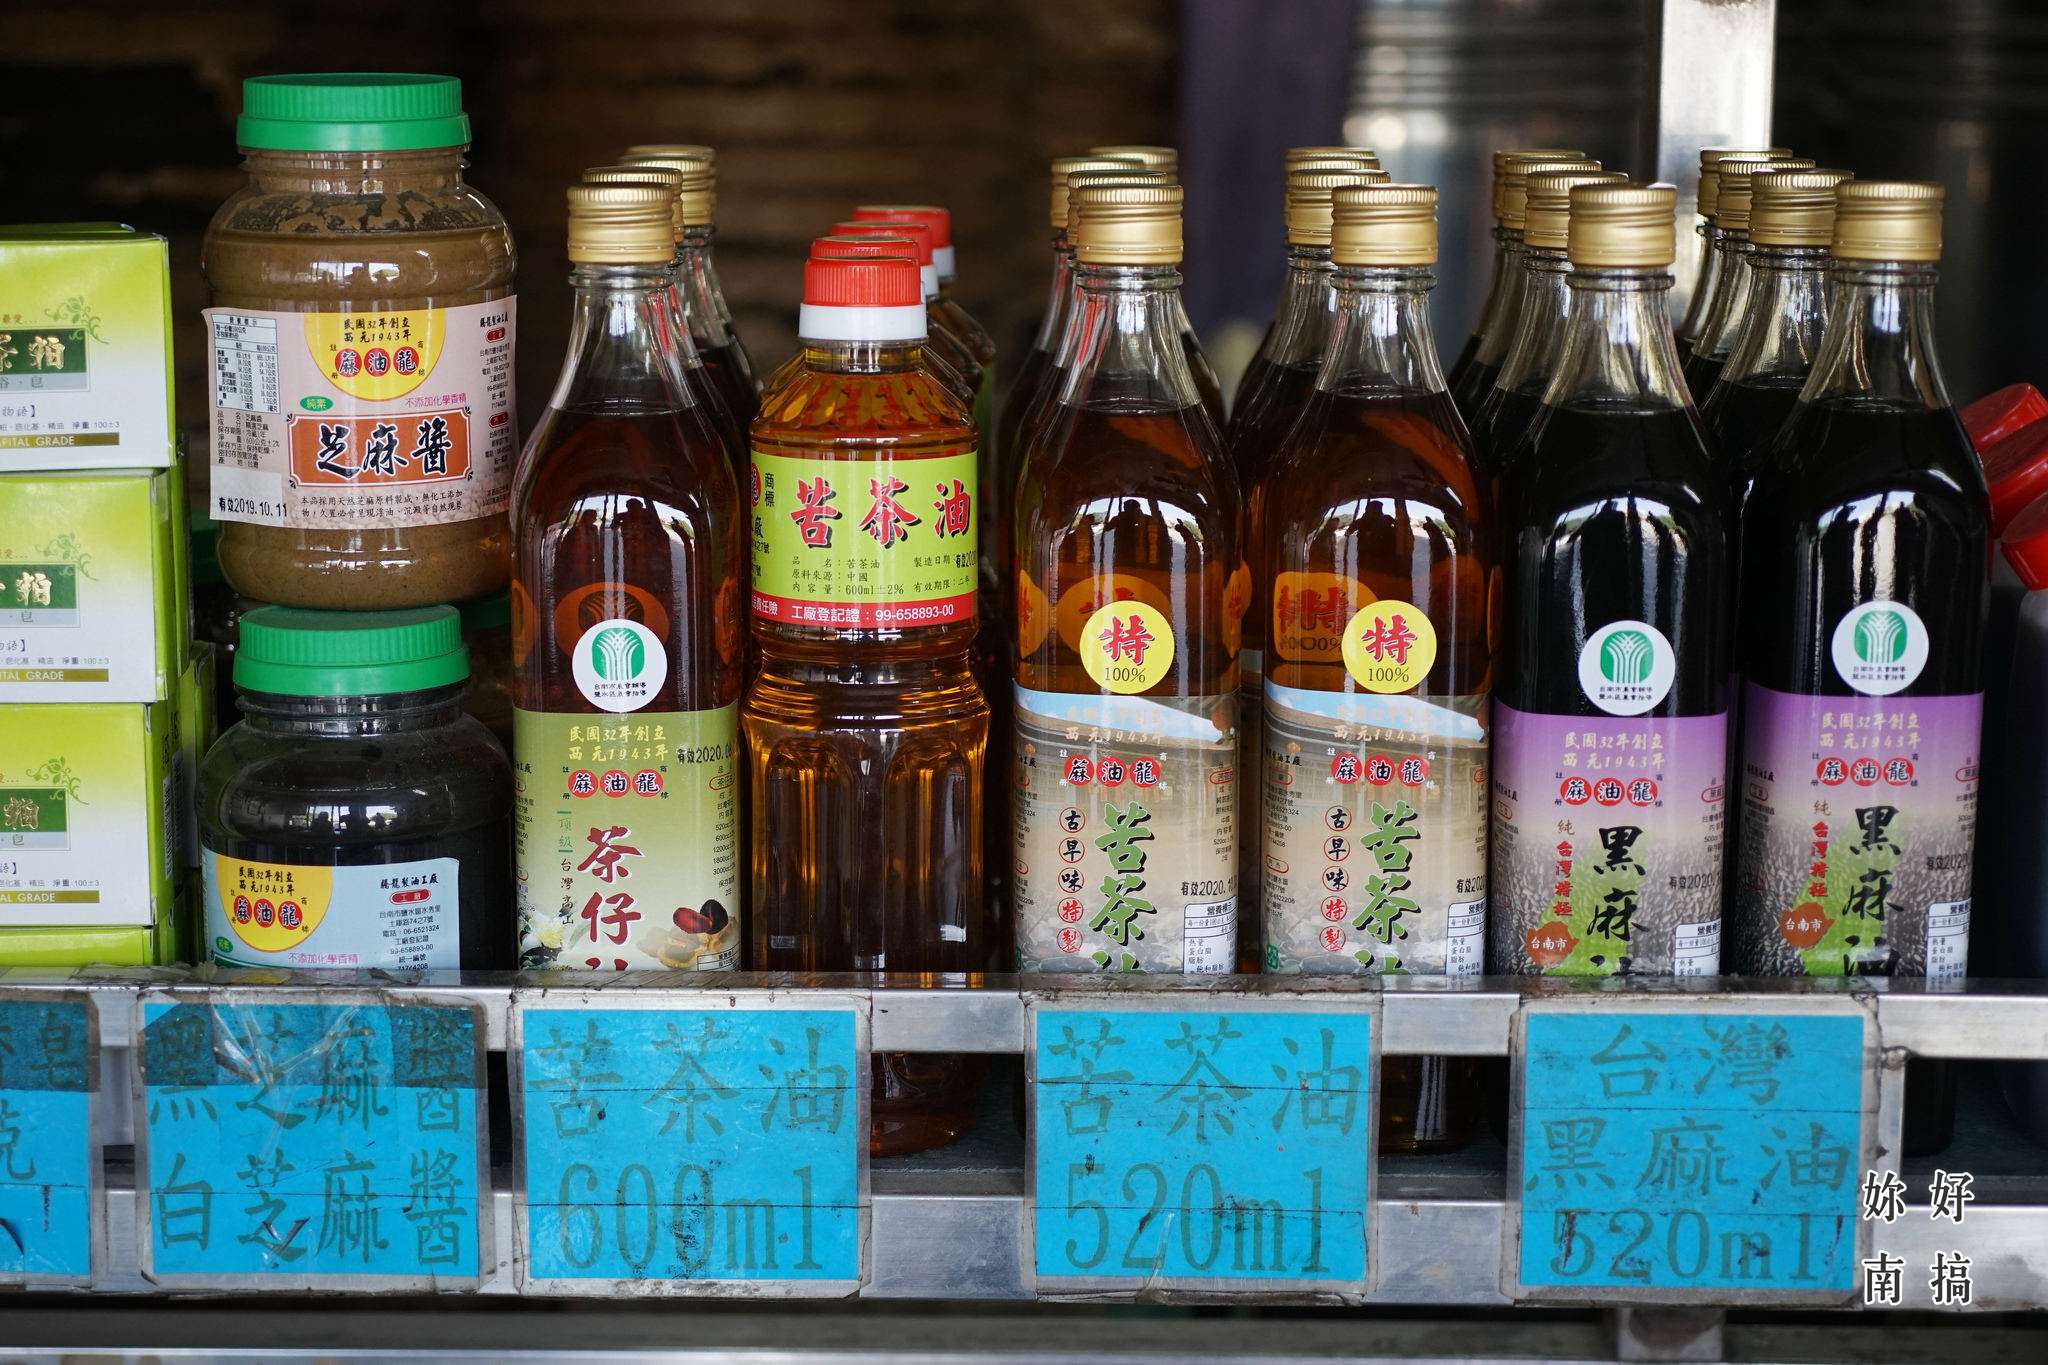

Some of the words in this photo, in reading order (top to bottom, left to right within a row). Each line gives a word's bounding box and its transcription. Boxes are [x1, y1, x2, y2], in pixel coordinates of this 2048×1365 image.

[35, 433, 75, 447] GRADE
[316, 416, 453, 480] 芝麻醬
[790, 474, 972, 550] 苦茶油
[1099, 614, 1154, 666] 特
[1360, 613, 1419, 665] 特
[25, 669, 64, 681] GRADE
[1103, 666, 1147, 684] 100%
[1367, 666, 1410, 683] 100%
[569, 724, 666, 743] 民國32年創立
[1565, 731, 1664, 751] 民國32年創立
[1820, 731, 1921, 750] 西元1943年
[1822, 711, 1920, 731] 民國32年創立
[568, 743, 669, 762] 西元1943年
[1562, 752, 1666, 770] 西元1943年
[557, 818, 573, 849] 頂級
[17, 891, 56, 903] GRADE
[559, 857, 575, 926] 台灣高山
[577, 825, 645, 971] 茶仔
[1061, 809, 1083, 952] 古早味特製
[1324, 808, 1349, 951] 古早味特製
[1531, 937, 1568, 952] 台南市
[1785, 917, 1824, 933] 台南市
[149, 1013, 473, 1134] 黑芝麻醬
[527, 1016, 850, 1144] 苦茶油
[1039, 1015, 1363, 1144] 苦茶油
[1591, 1021, 1794, 1106] 台灣
[1525, 1115, 1852, 1198] 黑麻油
[158, 1146, 469, 1267] 白芝麻醬
[557, 1162, 824, 1272] 600ml
[1064, 1162, 1331, 1273] 520ml
[1548, 1206, 1818, 1281] 520ml
